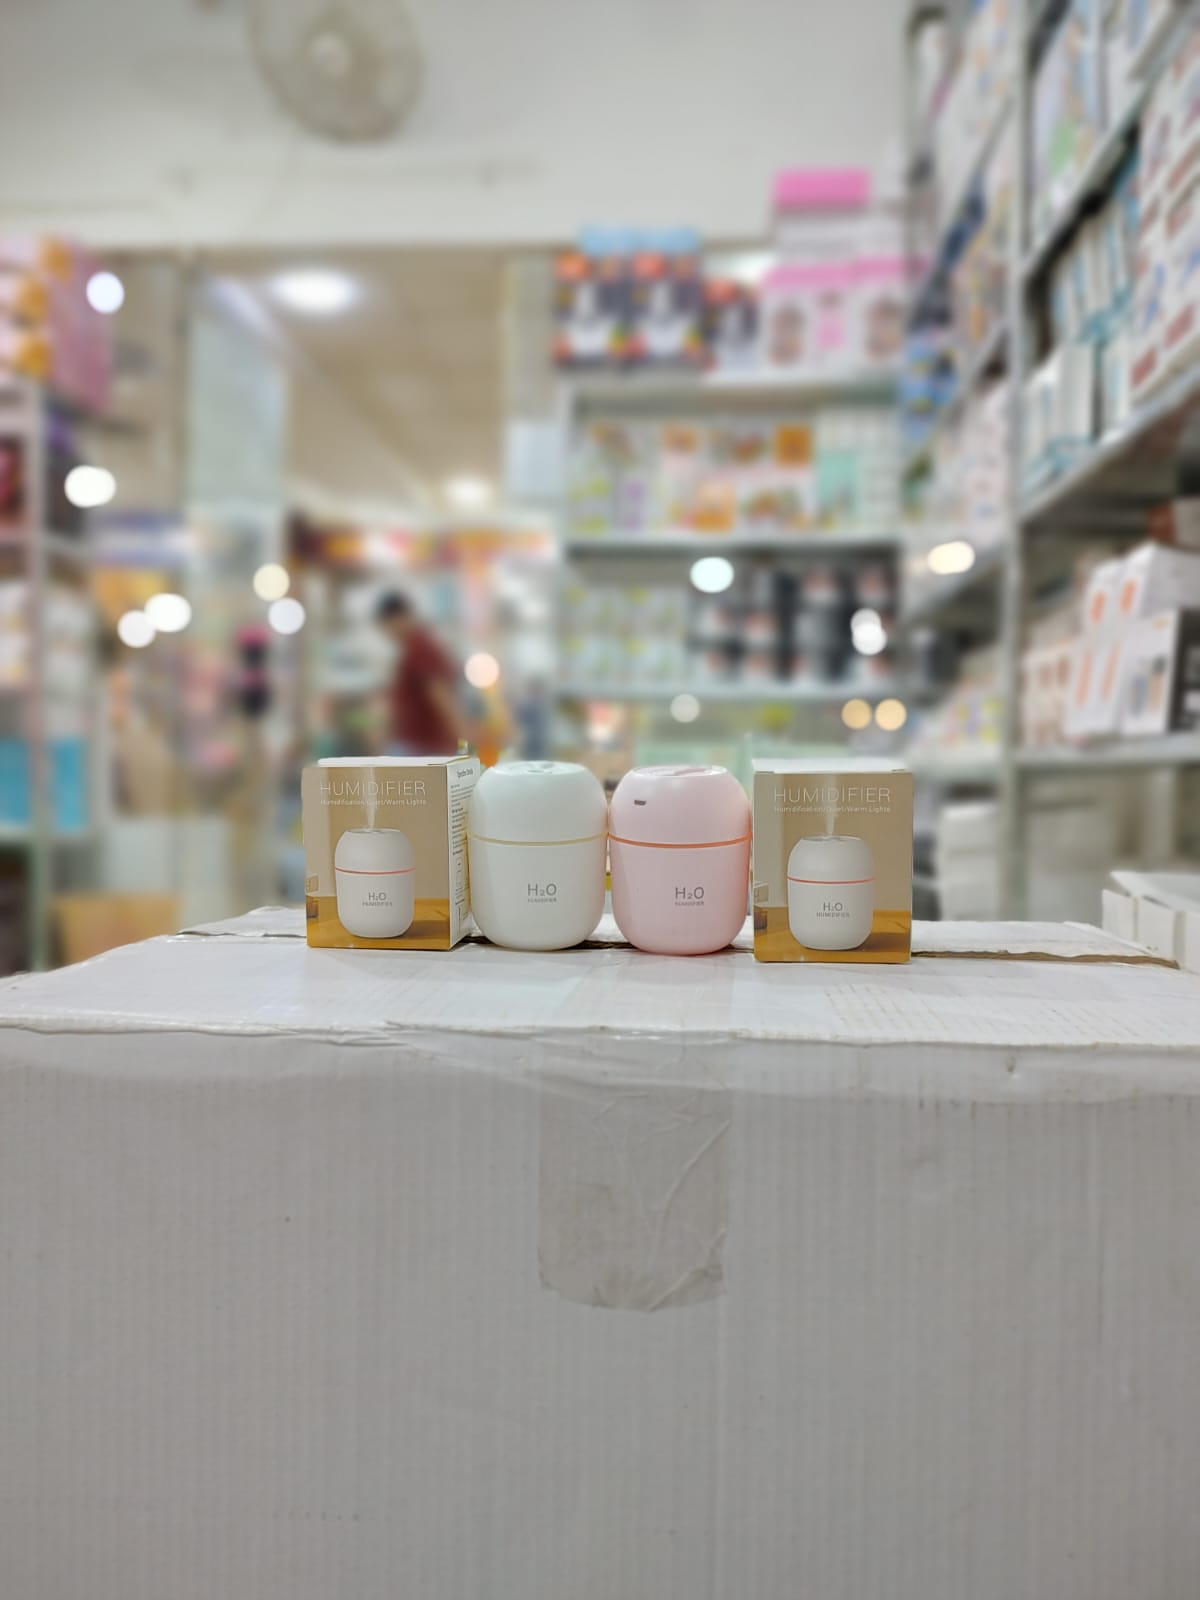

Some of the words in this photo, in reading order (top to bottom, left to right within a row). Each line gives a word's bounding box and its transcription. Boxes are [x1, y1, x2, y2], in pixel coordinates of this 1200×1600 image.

[319, 780, 427, 796] HUMIDIFIER
[773, 786, 891, 803] HUMIDIFIER
[868, 805, 891, 814] Lights
